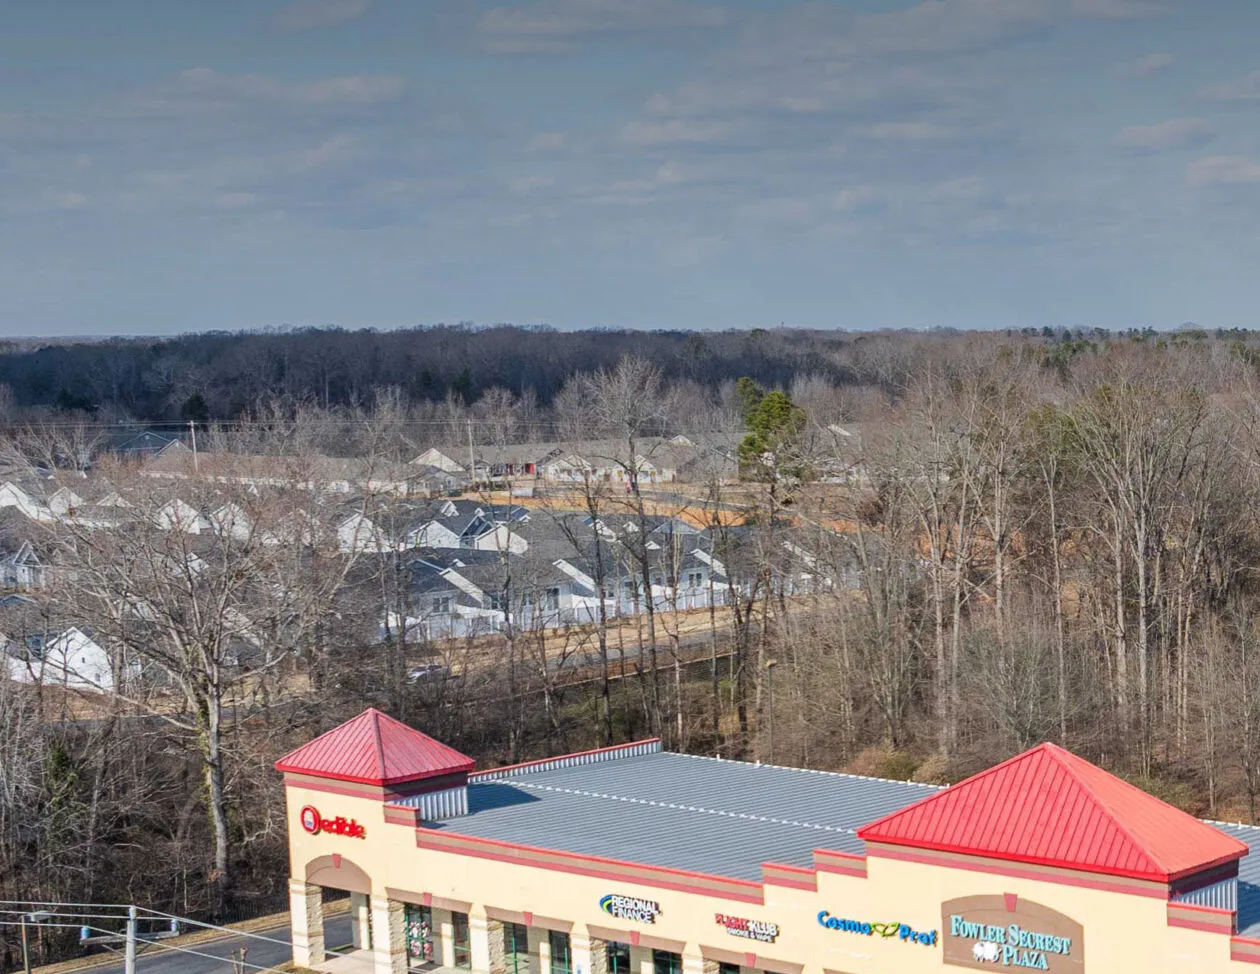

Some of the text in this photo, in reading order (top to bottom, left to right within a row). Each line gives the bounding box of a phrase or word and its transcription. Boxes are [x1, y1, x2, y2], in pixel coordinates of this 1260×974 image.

[611, 894, 661, 915] REGIONAL
[611, 906, 656, 924] FINANCE
[750, 919, 780, 937] KLUB
[817, 910, 938, 946] Cosmo Prof
[950, 914, 1072, 955] FOWLER SECREST
[1001, 944, 1049, 971] PLAZA
